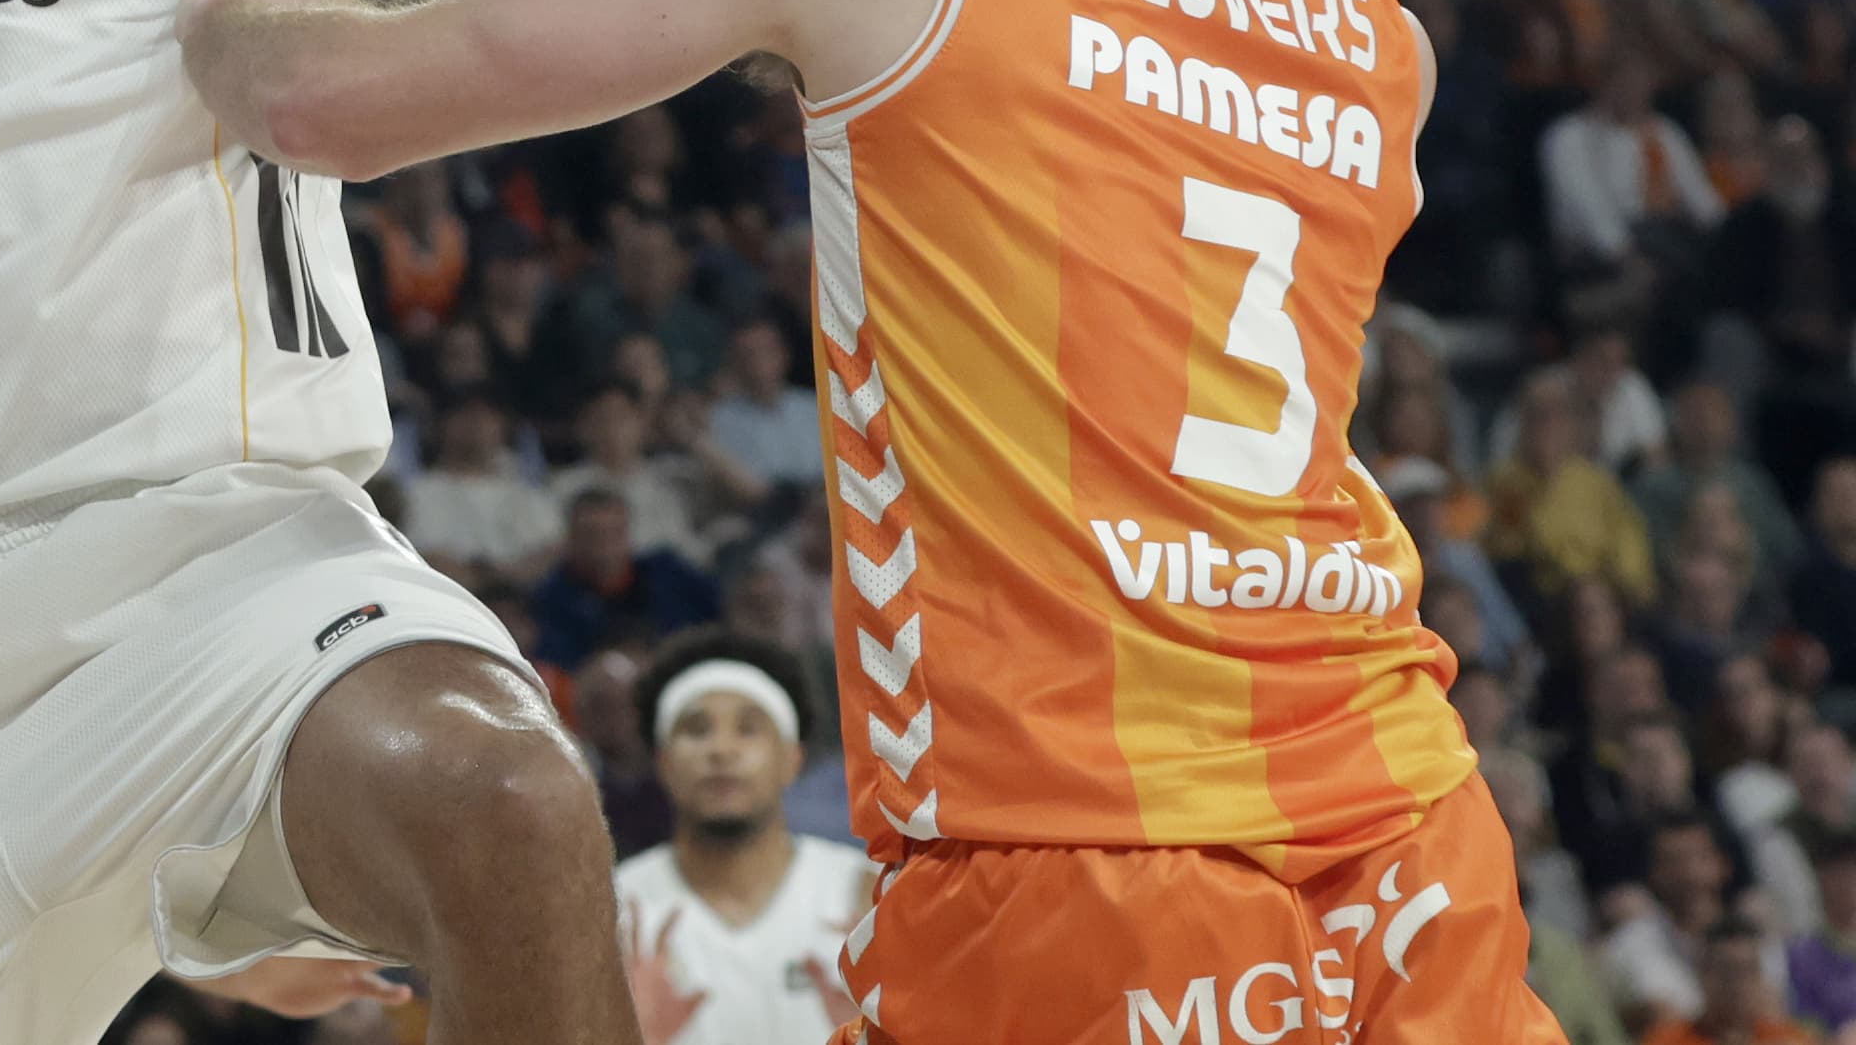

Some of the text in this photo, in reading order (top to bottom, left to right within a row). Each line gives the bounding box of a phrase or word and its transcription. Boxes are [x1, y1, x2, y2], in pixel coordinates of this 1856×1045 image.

[1068, 15, 1382, 189] PAMESA
[1170, 176, 1317, 496] 3
[323, 615, 369, 647] acb
